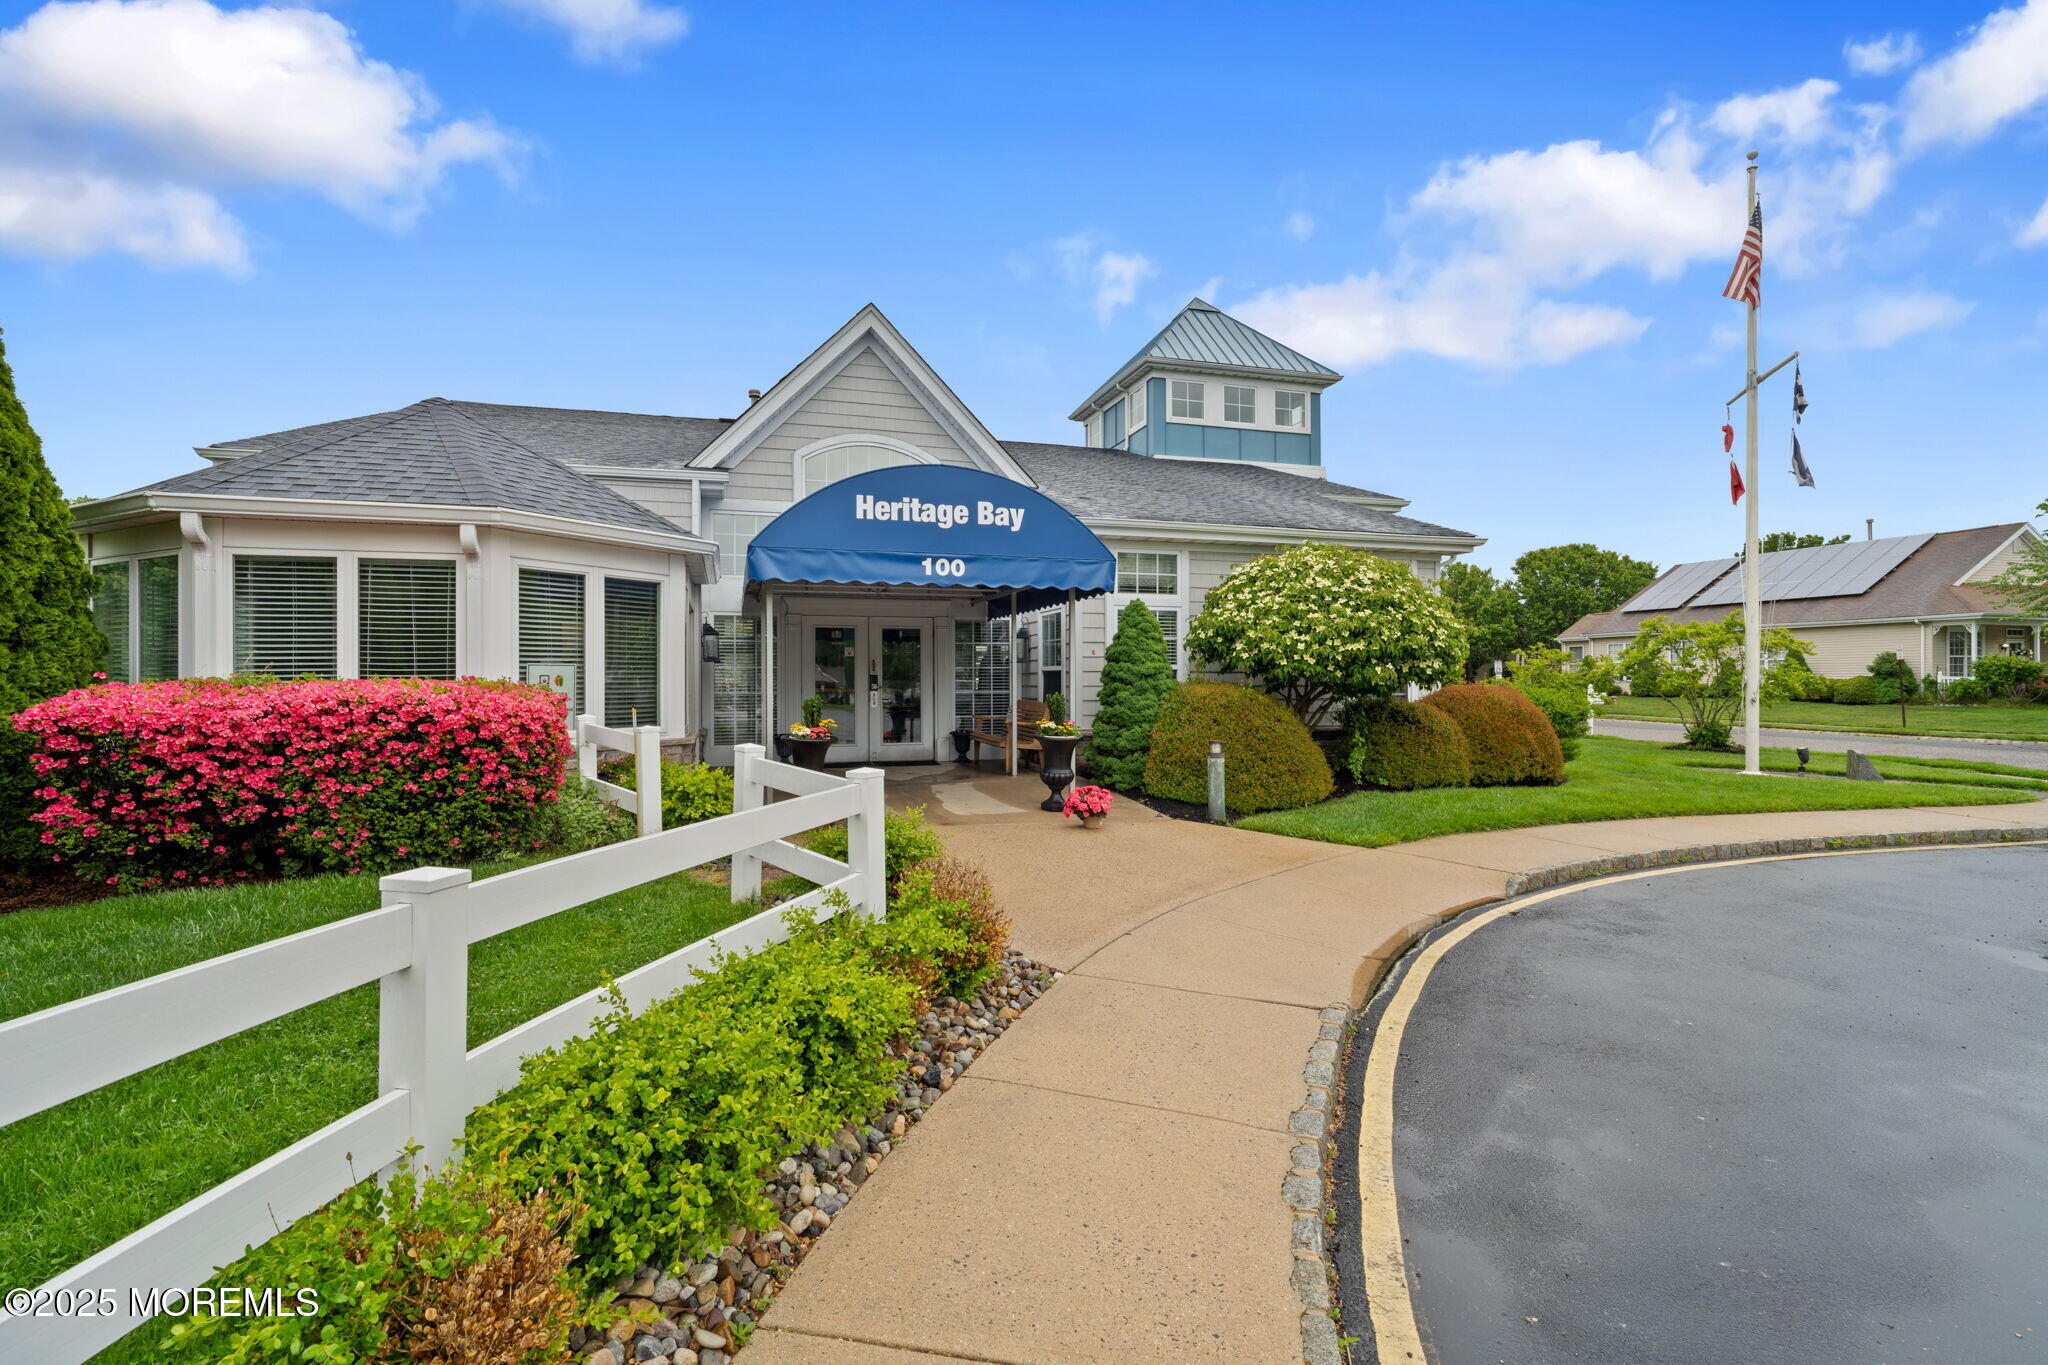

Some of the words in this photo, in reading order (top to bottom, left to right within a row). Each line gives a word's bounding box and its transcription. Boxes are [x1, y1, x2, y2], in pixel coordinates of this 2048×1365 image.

[855, 494, 969, 529] Heritage
[977, 500, 1025, 532] Bay
[921, 557, 966, 578] 100
